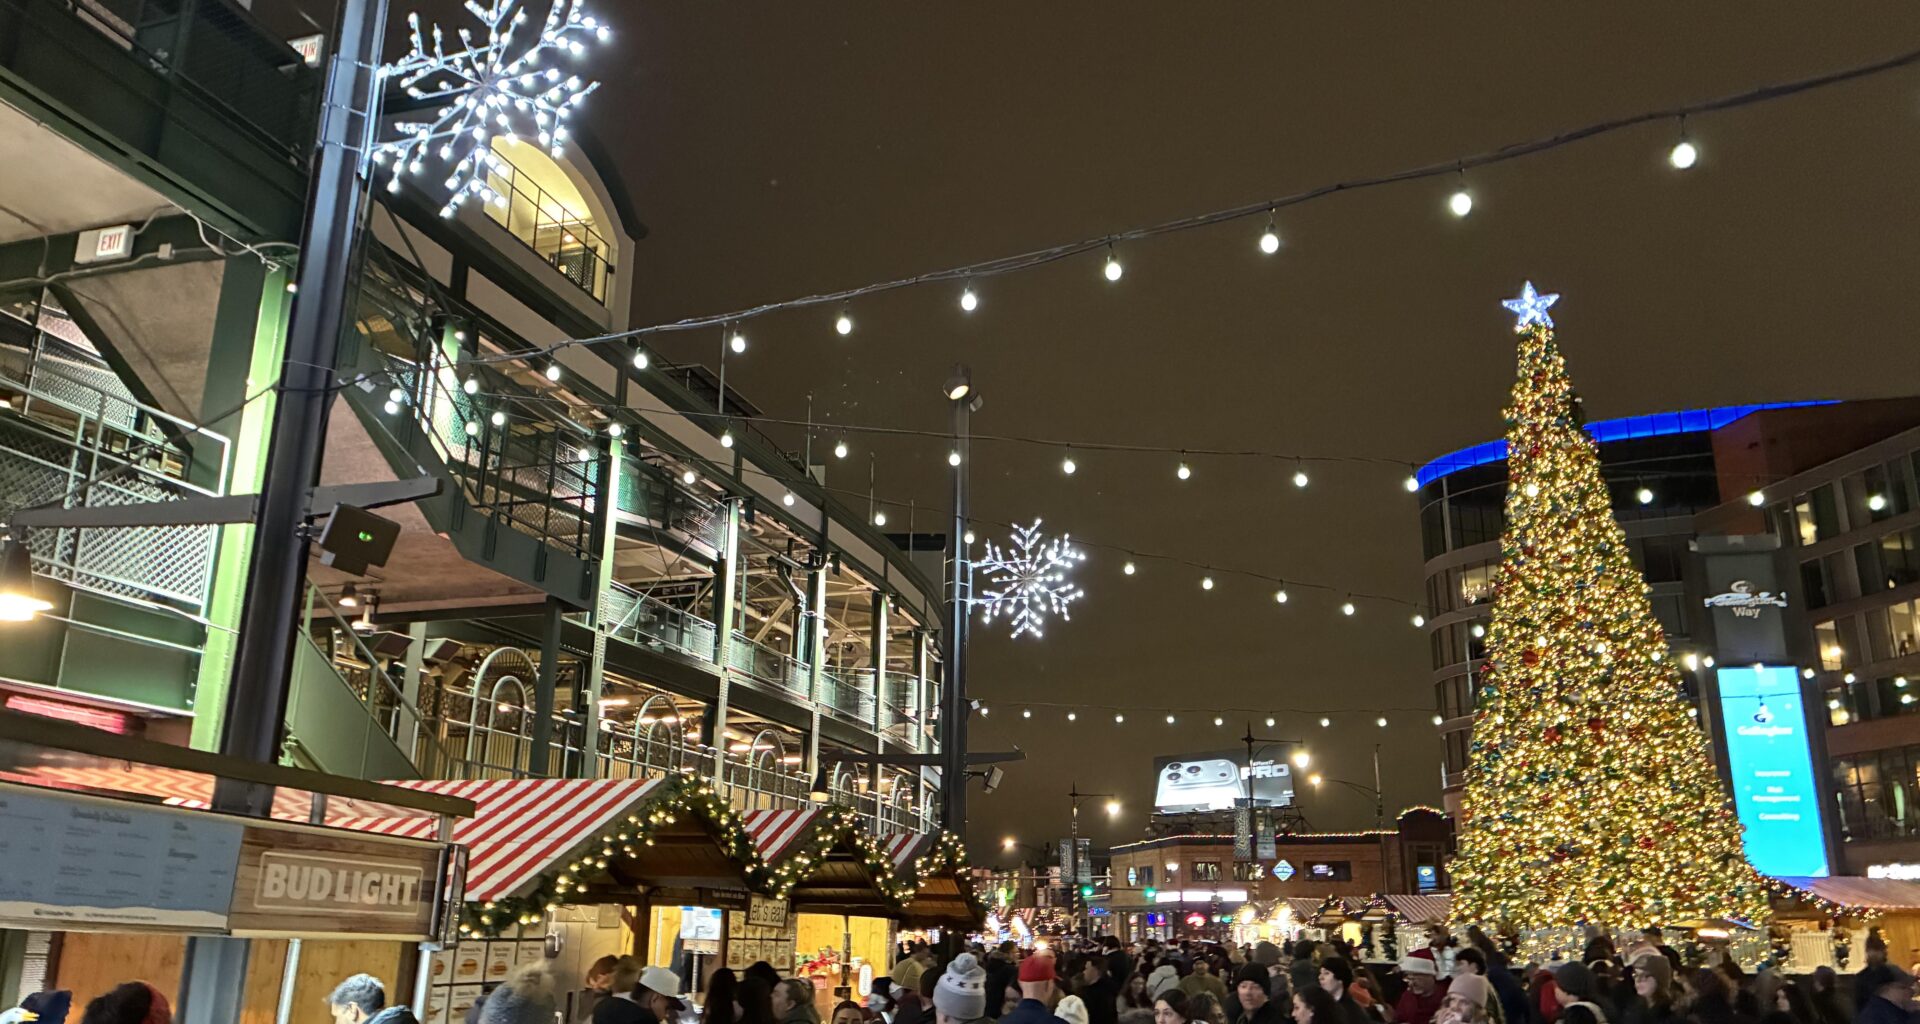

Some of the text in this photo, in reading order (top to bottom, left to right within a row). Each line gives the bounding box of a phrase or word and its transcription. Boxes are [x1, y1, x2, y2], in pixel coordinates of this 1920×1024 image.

[101, 232, 123, 251] EXIT
[1732, 606, 1760, 619] Way
[1240, 764, 1289, 780] PRO
[263, 863, 332, 900] BUD
[334, 869, 418, 906] LIGHT
[771, 906, 785, 923] eat
